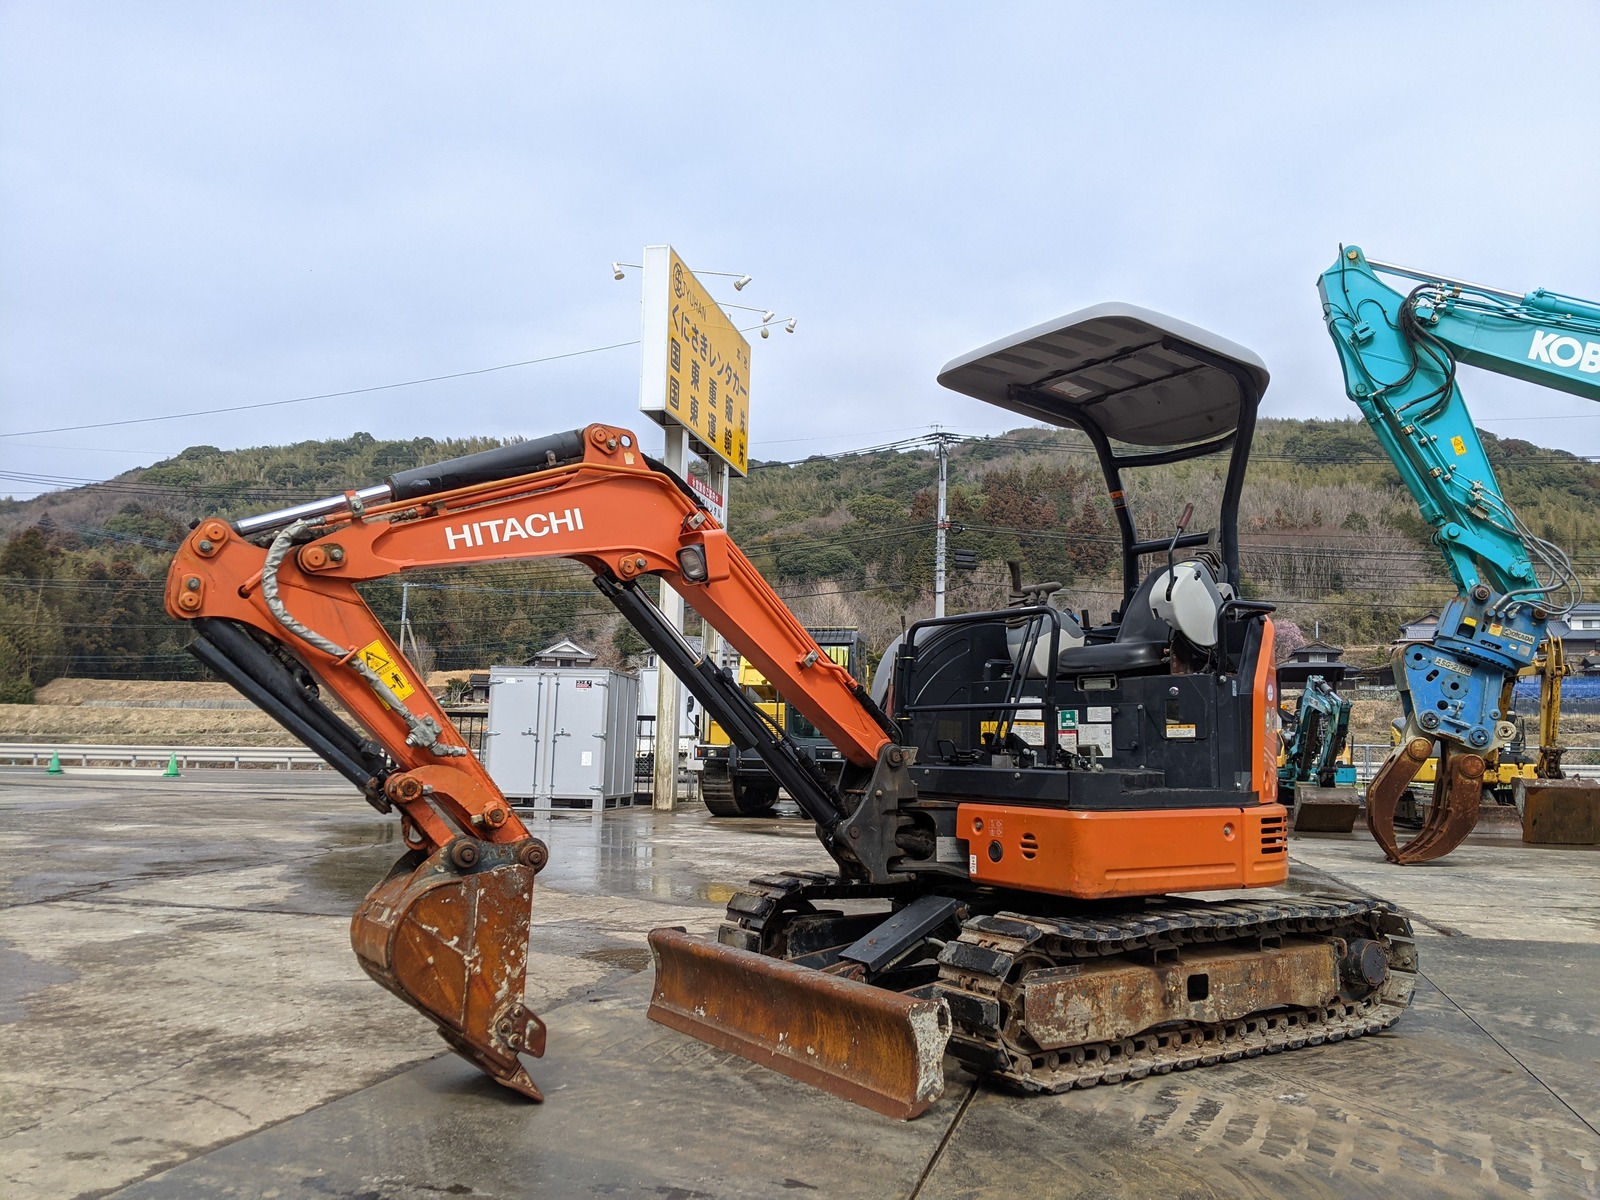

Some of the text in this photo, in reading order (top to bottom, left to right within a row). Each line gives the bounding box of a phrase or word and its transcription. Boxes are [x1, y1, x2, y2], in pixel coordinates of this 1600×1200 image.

[672, 304, 747, 396] くにさきレンタカー
[1527, 329, 1600, 374] KOB
[444, 507, 584, 550] HITACHI
